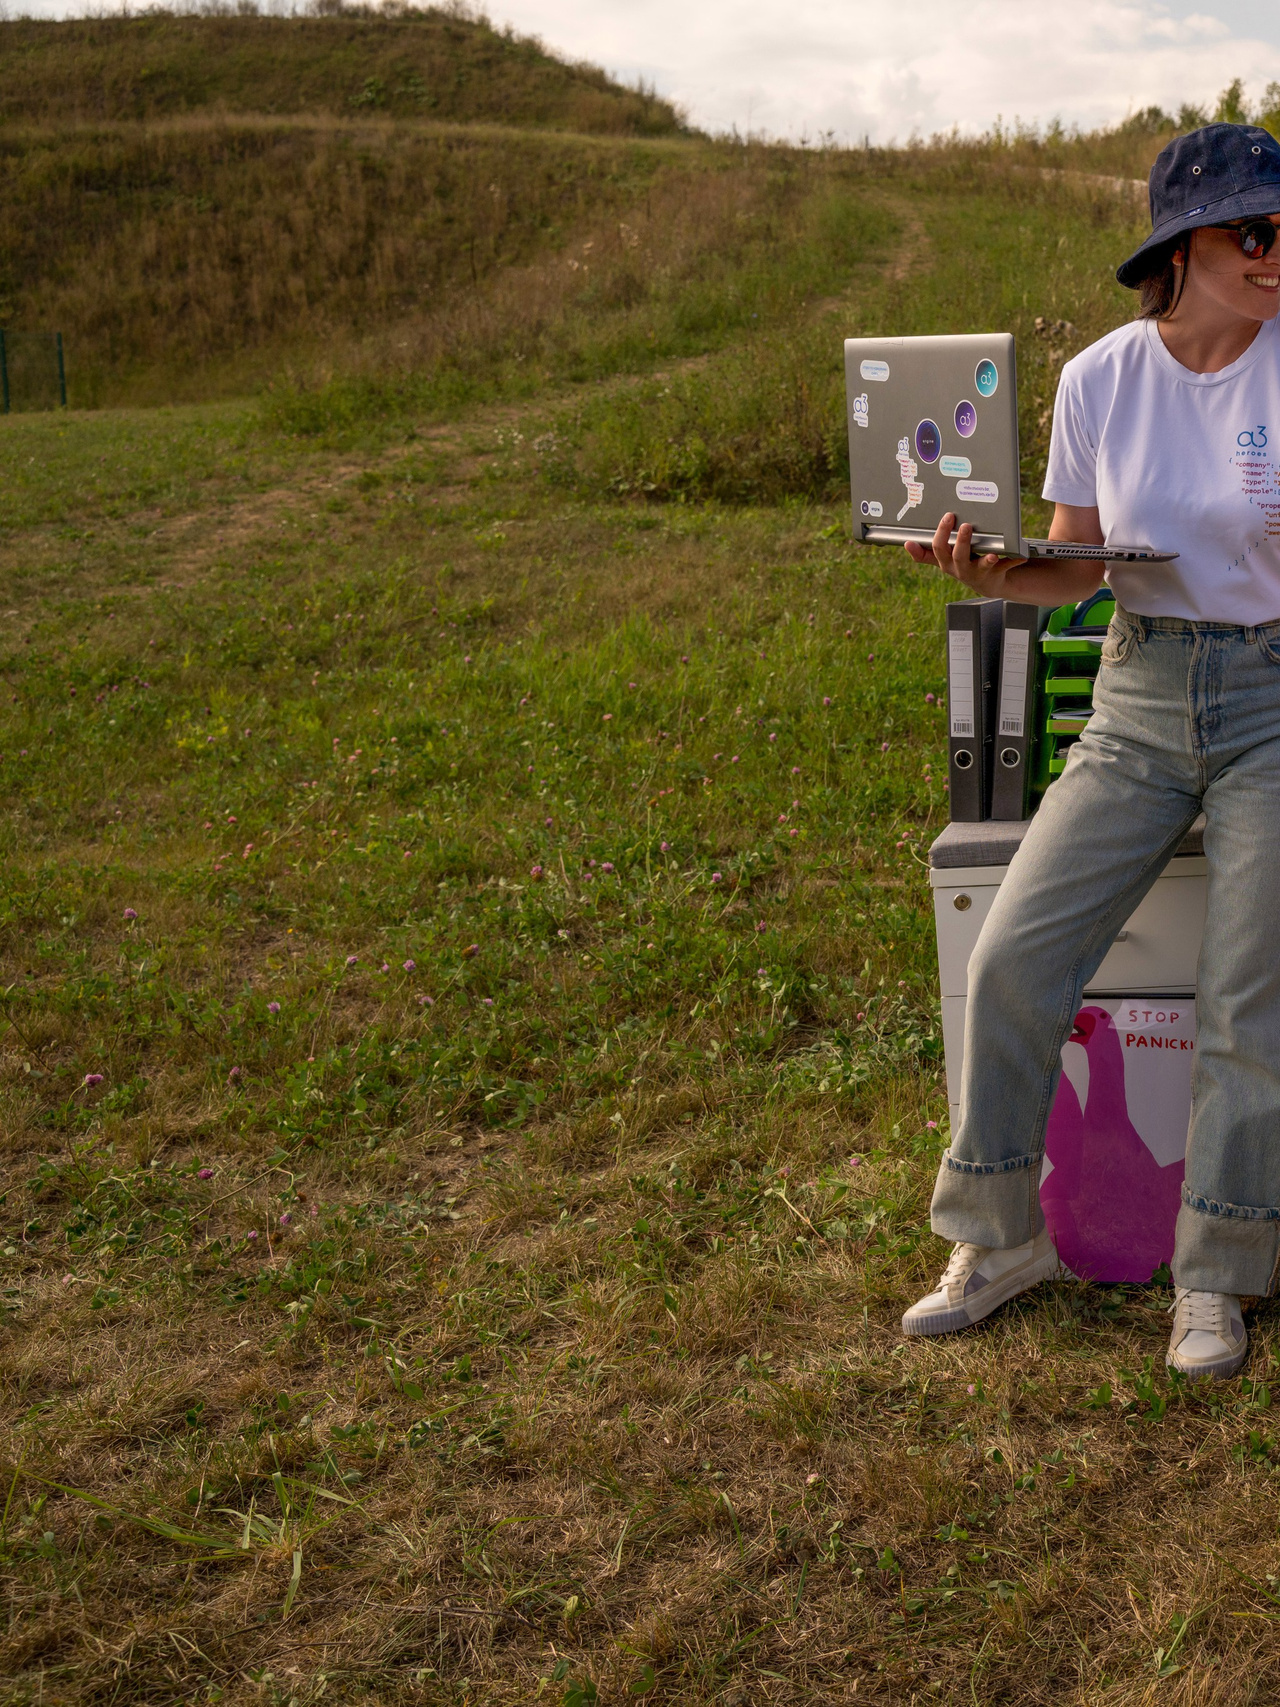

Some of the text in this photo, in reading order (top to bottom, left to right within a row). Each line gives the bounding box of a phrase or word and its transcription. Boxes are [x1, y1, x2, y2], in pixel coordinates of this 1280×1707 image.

[1237, 425, 1268, 448] a3
[1129, 1010, 1180, 1023] STOP
[1126, 1033, 1194, 1050] PANICKI
